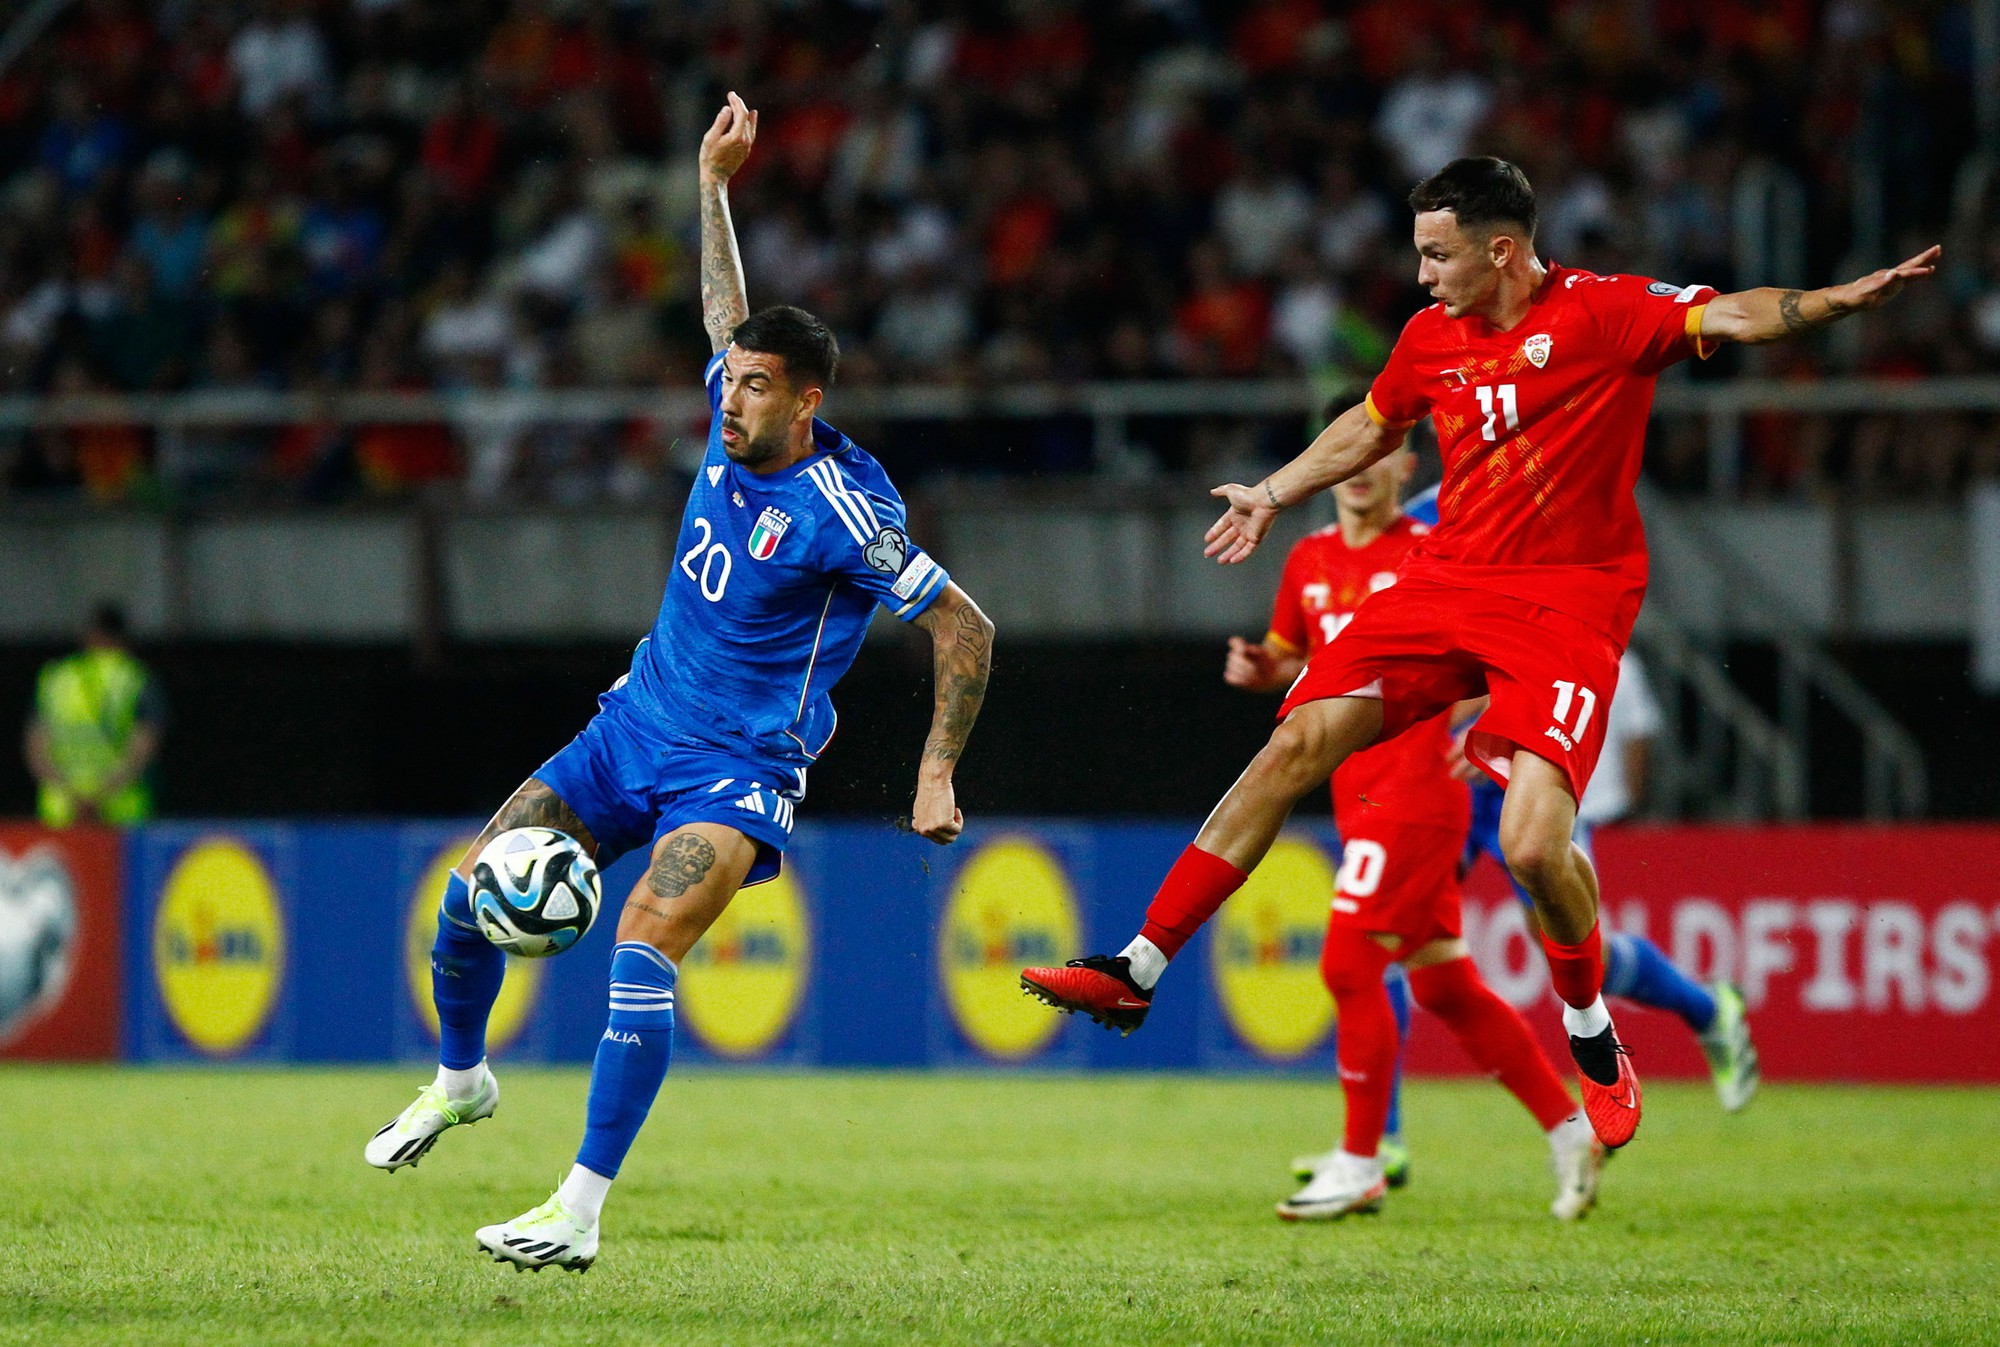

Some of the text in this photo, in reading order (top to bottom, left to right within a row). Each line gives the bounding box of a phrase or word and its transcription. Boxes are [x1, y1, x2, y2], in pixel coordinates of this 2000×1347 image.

[1475, 384, 1520, 441] 11
[760, 514, 784, 534] ITALIA
[680, 517, 732, 602] 20
[1544, 726, 1572, 752] JAKO
[1552, 679, 1596, 744] 11
